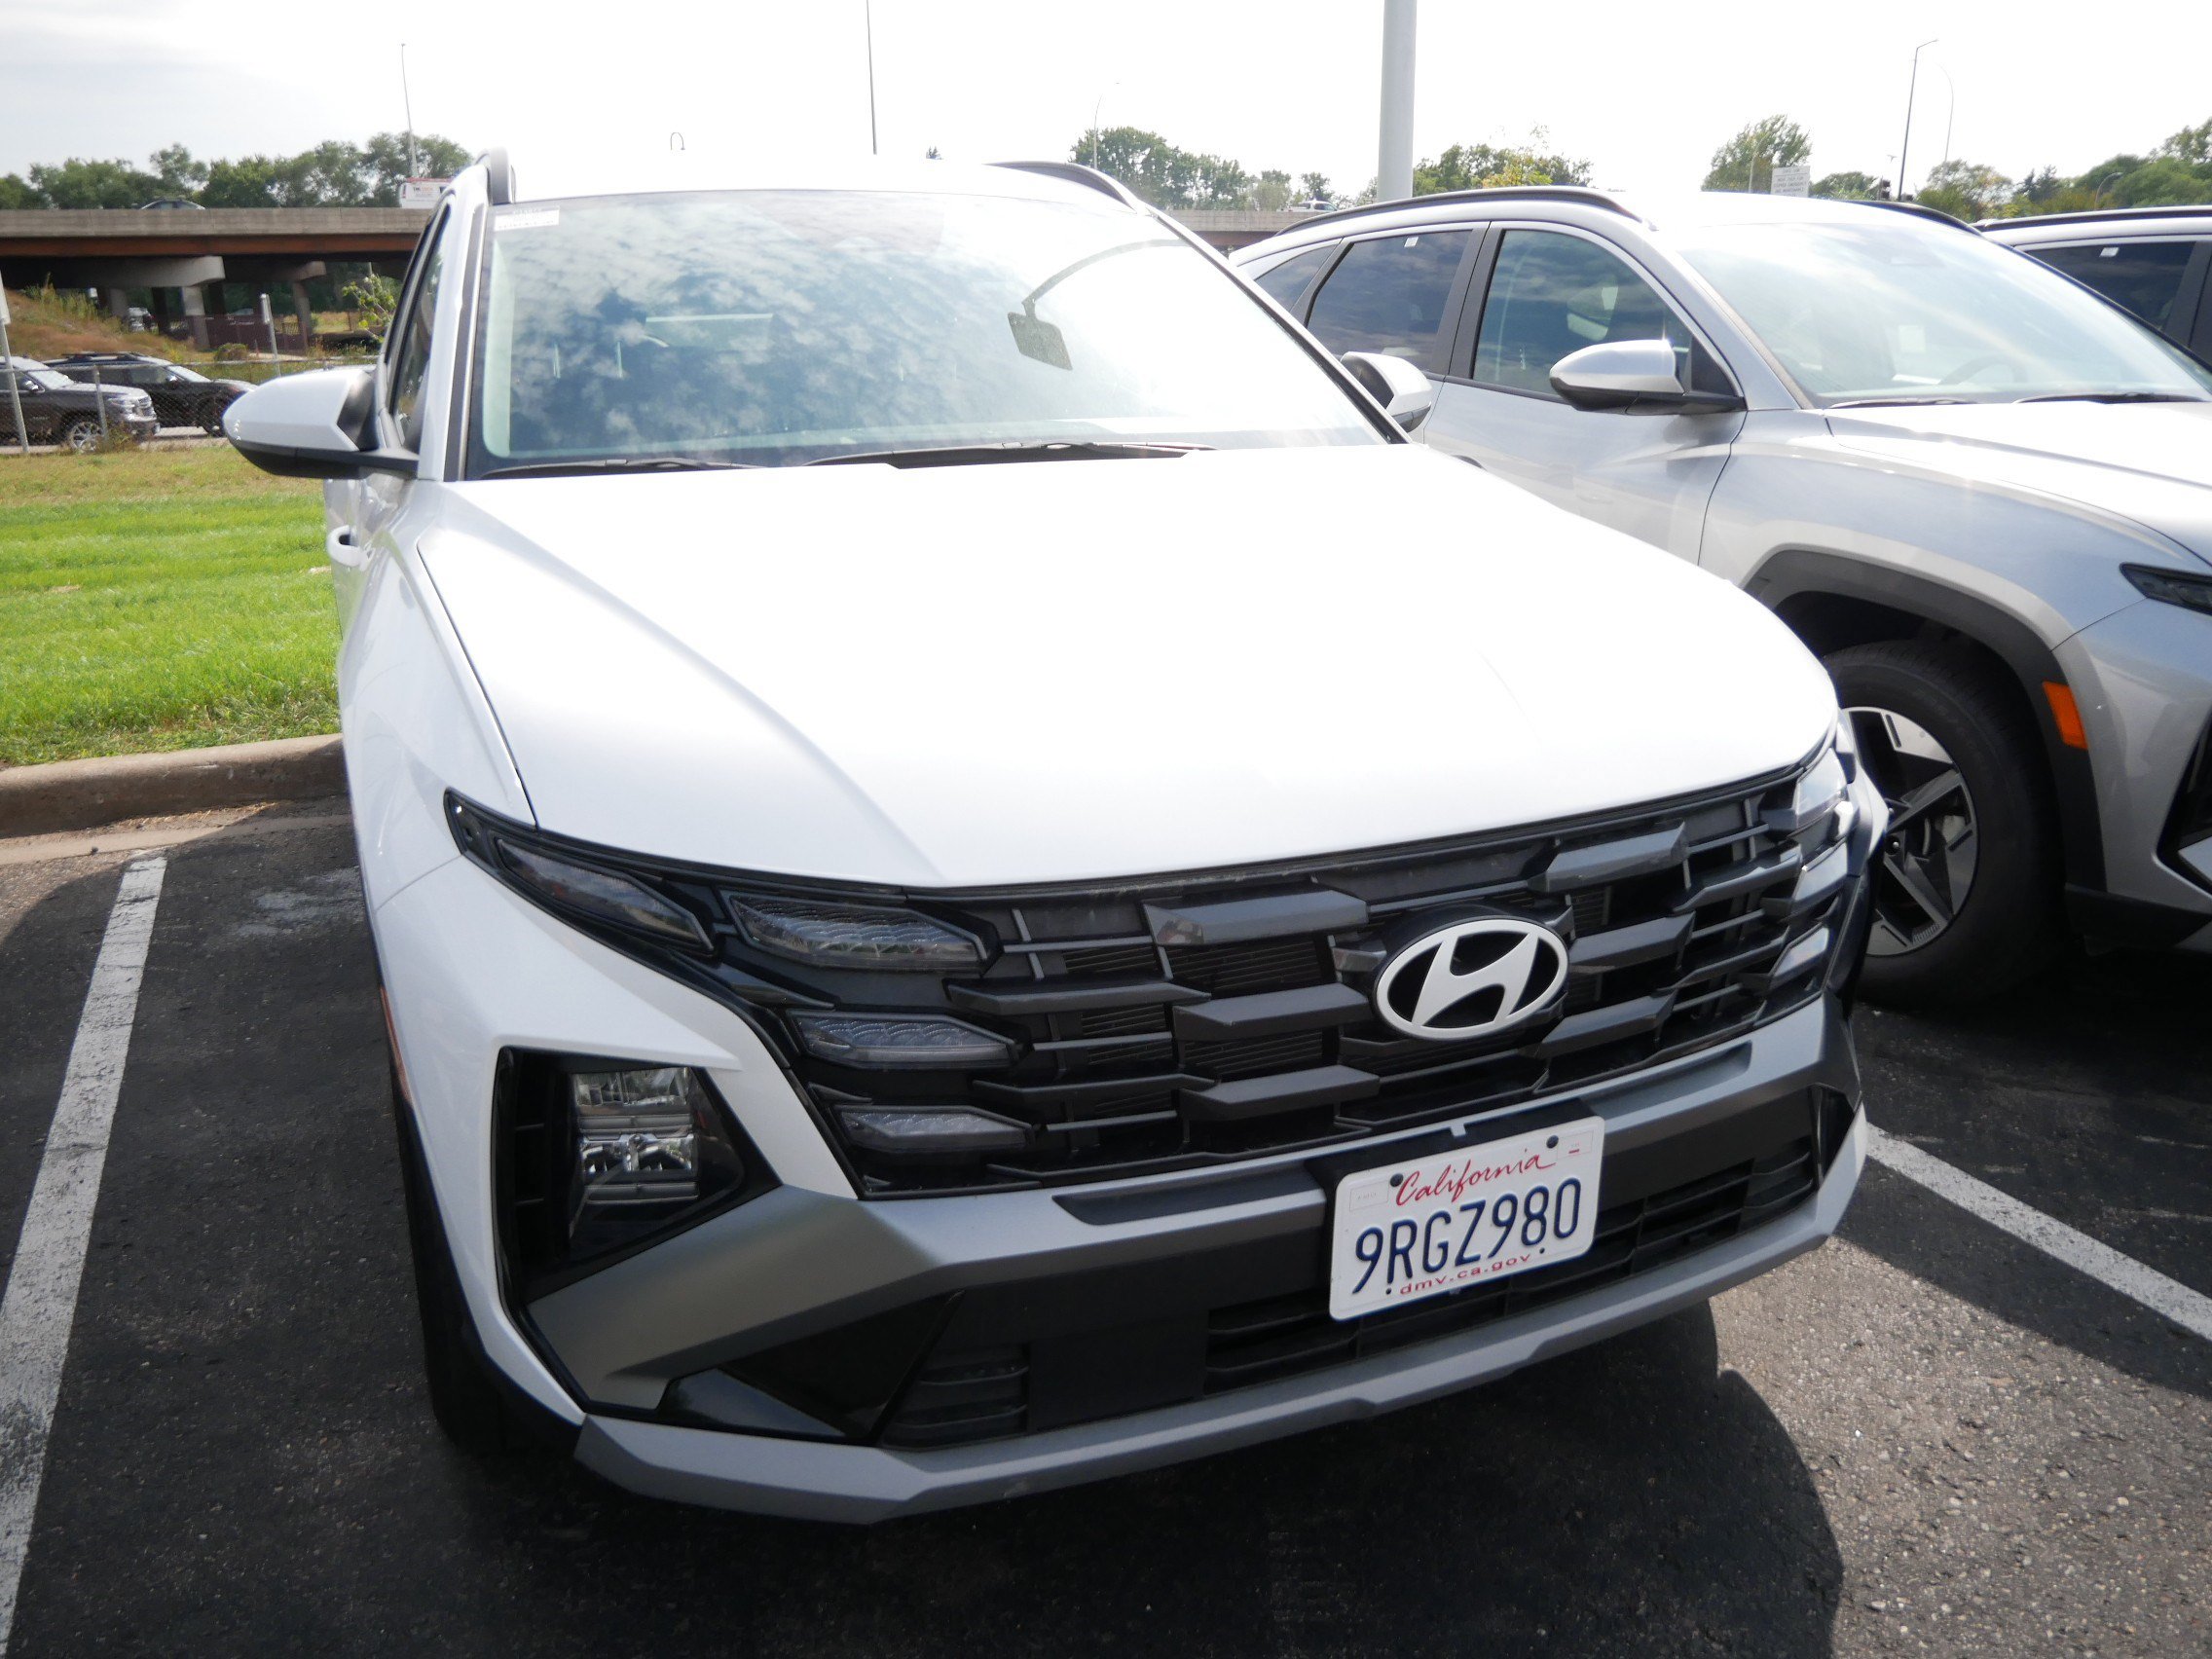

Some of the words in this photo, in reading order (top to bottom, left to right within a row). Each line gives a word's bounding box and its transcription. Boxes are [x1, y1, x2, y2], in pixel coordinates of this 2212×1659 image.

[1396, 1151, 1556, 1206] California
[1352, 1177, 1582, 1295] 9RGZ980
[1399, 1253, 1531, 1295] dmv.ca.gov
